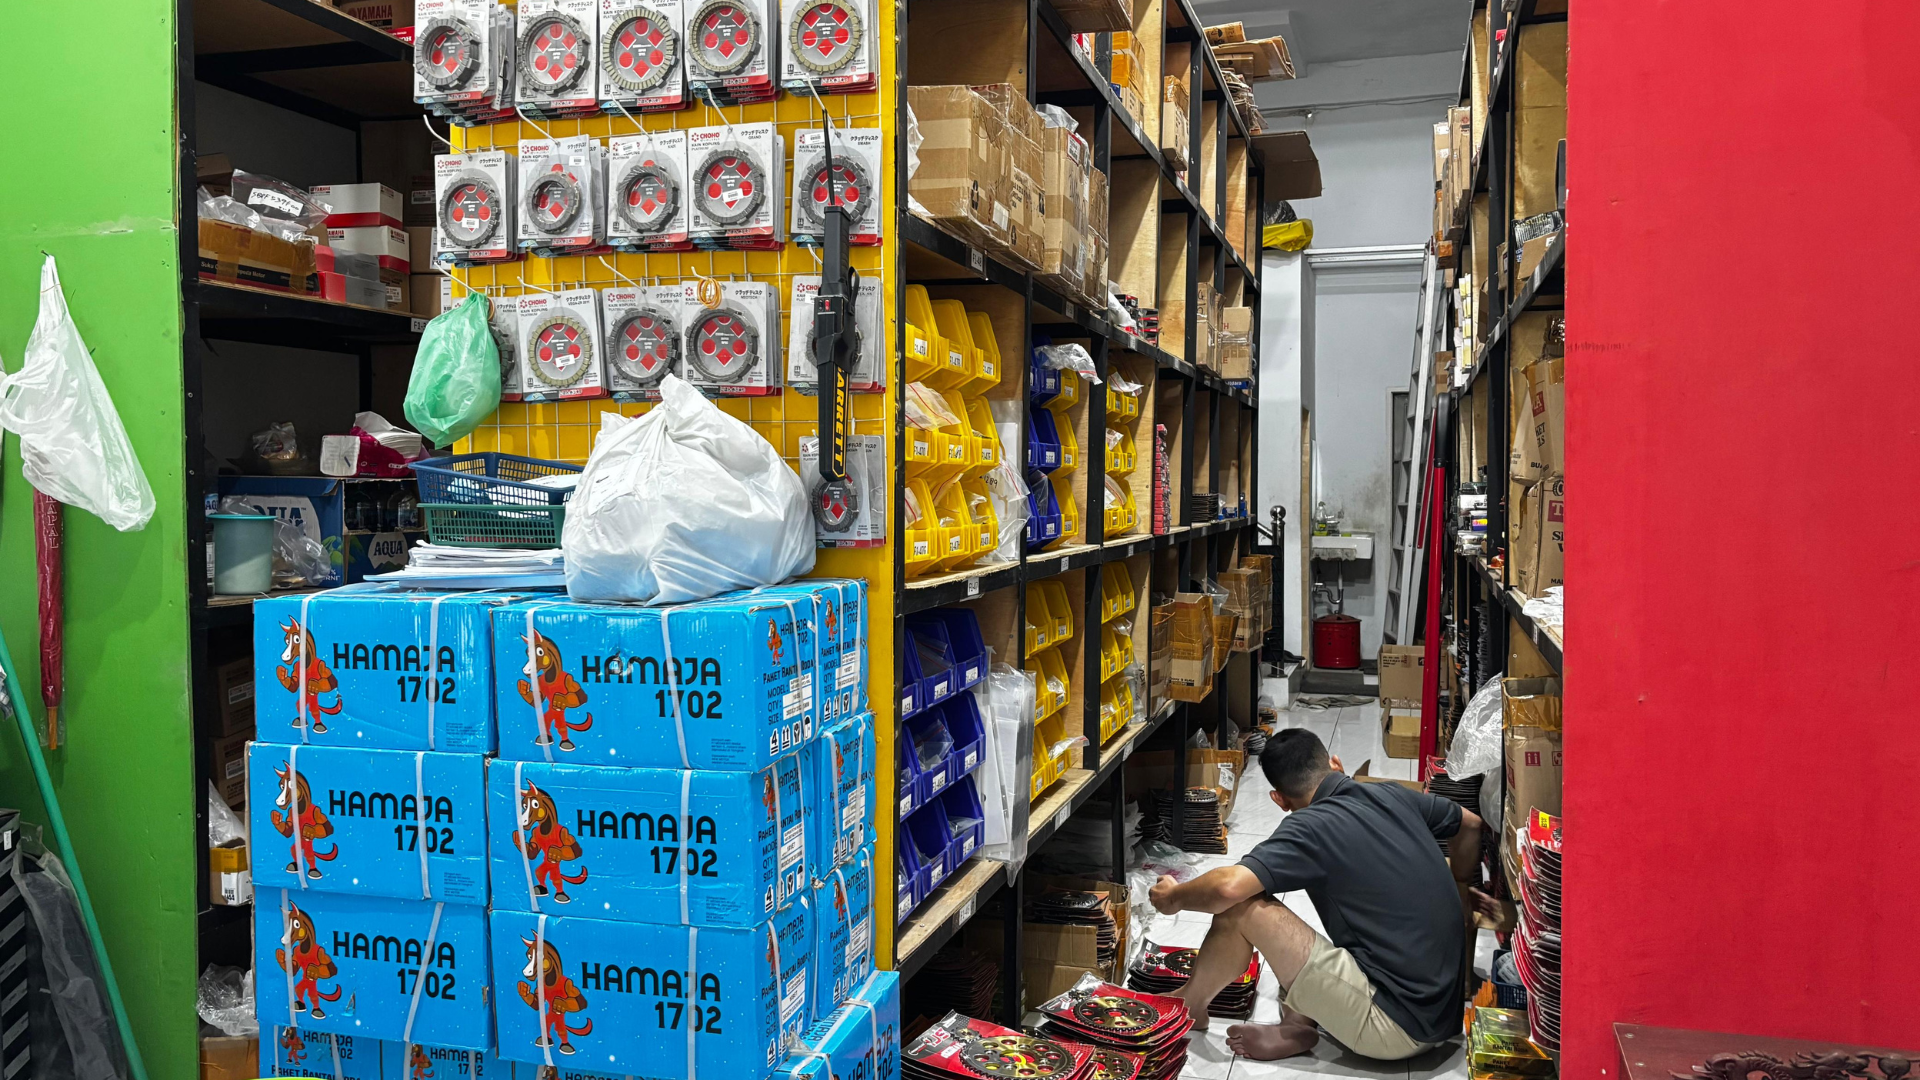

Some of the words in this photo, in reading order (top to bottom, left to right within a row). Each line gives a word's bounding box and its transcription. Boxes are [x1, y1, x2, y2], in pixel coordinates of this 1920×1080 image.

[357, 5, 393, 20] YAMAHA
[834, 367, 845, 468] ARRETT
[373, 541, 404, 557] AQUA
[333, 642, 456, 673] HAMAJA
[581, 655, 722, 686] HAMAJA
[397, 676, 457, 705] 1702
[655, 689, 723, 719] 1702
[329, 789, 455, 824] HAMAJA
[394, 824, 456, 855] 1702
[577, 809, 718, 845] HAMAJA
[650, 846, 719, 878] 1702
[332, 930, 456, 969] HAMAJA
[397, 968, 456, 1001] 1702
[581, 961, 721, 1002] HAMAJA
[655, 1001, 722, 1035] 1702
